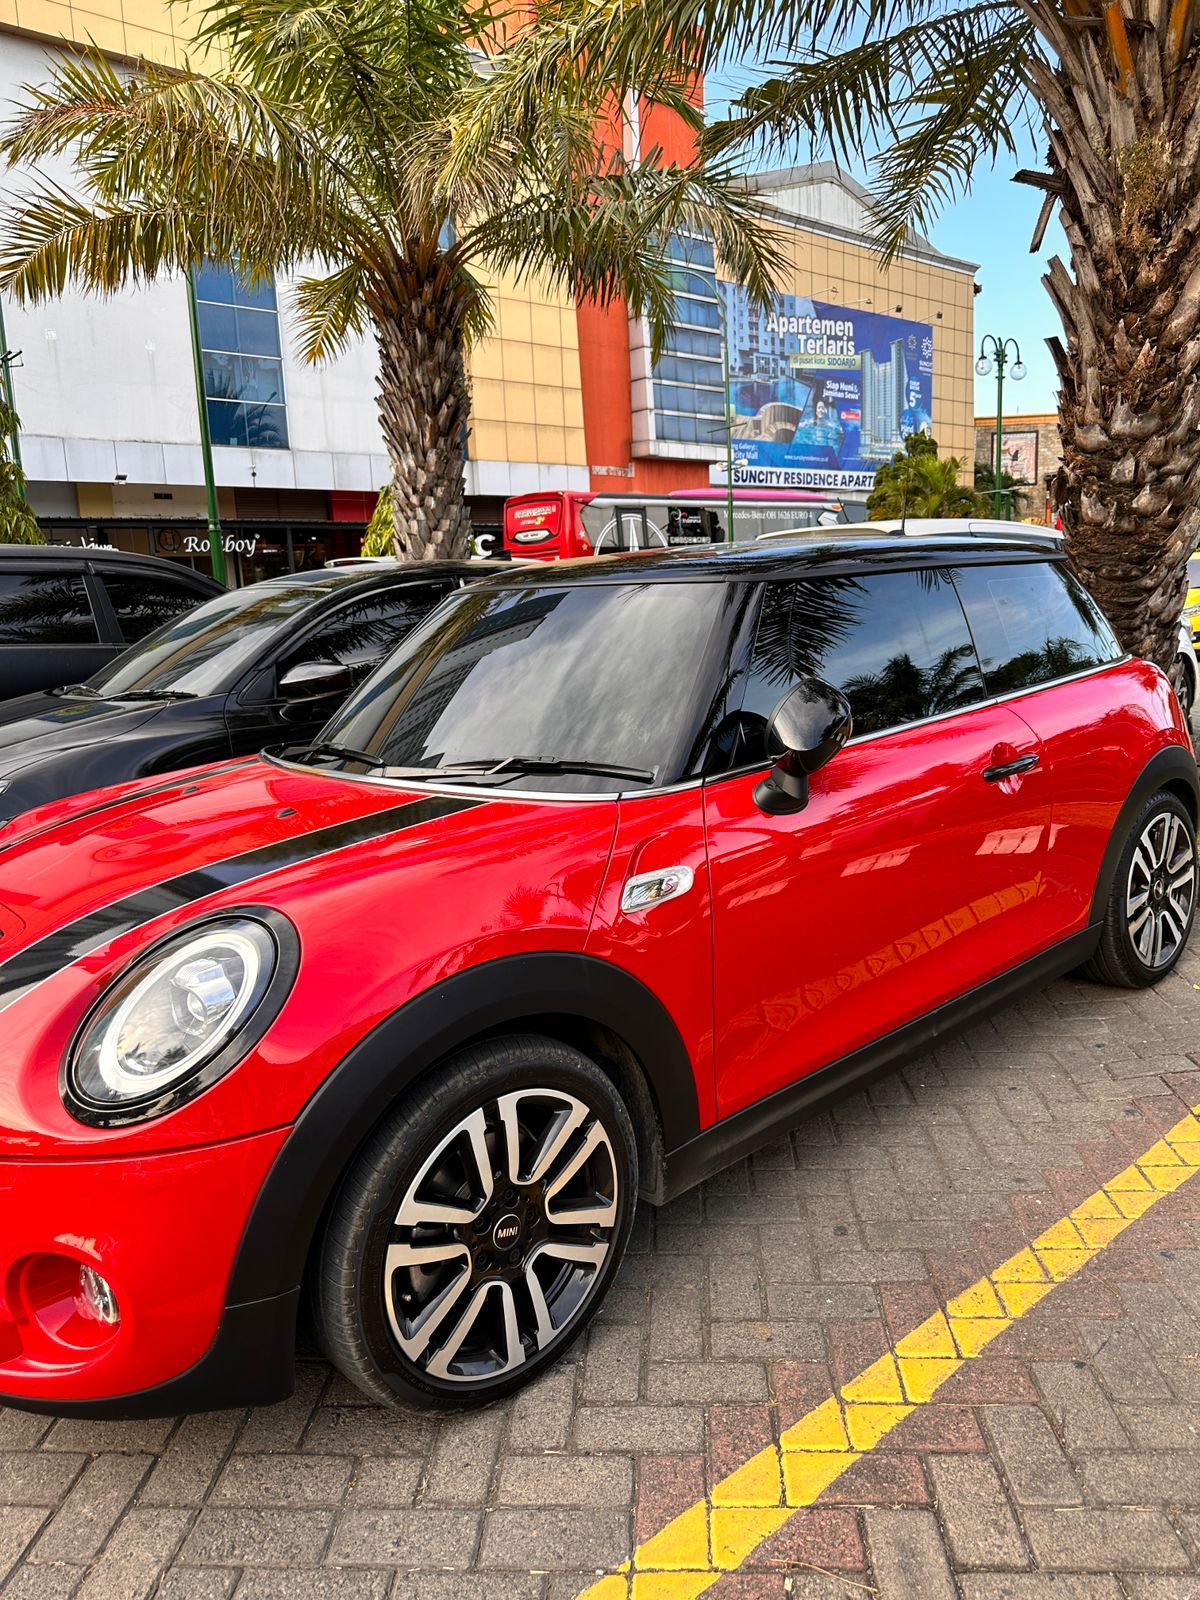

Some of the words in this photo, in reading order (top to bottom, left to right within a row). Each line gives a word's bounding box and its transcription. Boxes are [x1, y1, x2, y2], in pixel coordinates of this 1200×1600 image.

[767, 313, 853, 337] Apartemen
[798, 336, 855, 356] Terlaris
[813, 357, 826, 365] kota
[827, 358, 857, 369] SIDOARJO
[826, 380, 839, 391] Siap
[840, 381, 853, 392] Huni
[823, 388, 844, 398] Jaminan
[746, 451, 758, 459] Mall
[733, 469, 782, 485] SUNCITY
[784, 471, 838, 487] RESIDENCE
[840, 474, 876, 488] APART
[723, 510, 766, 519] Mrcedes-Benz
[767, 511, 776, 520] OH
[791, 511, 808, 520] EURO
[184, 534, 257, 557] Roboy
[498, 1226, 518, 1239] MINI
